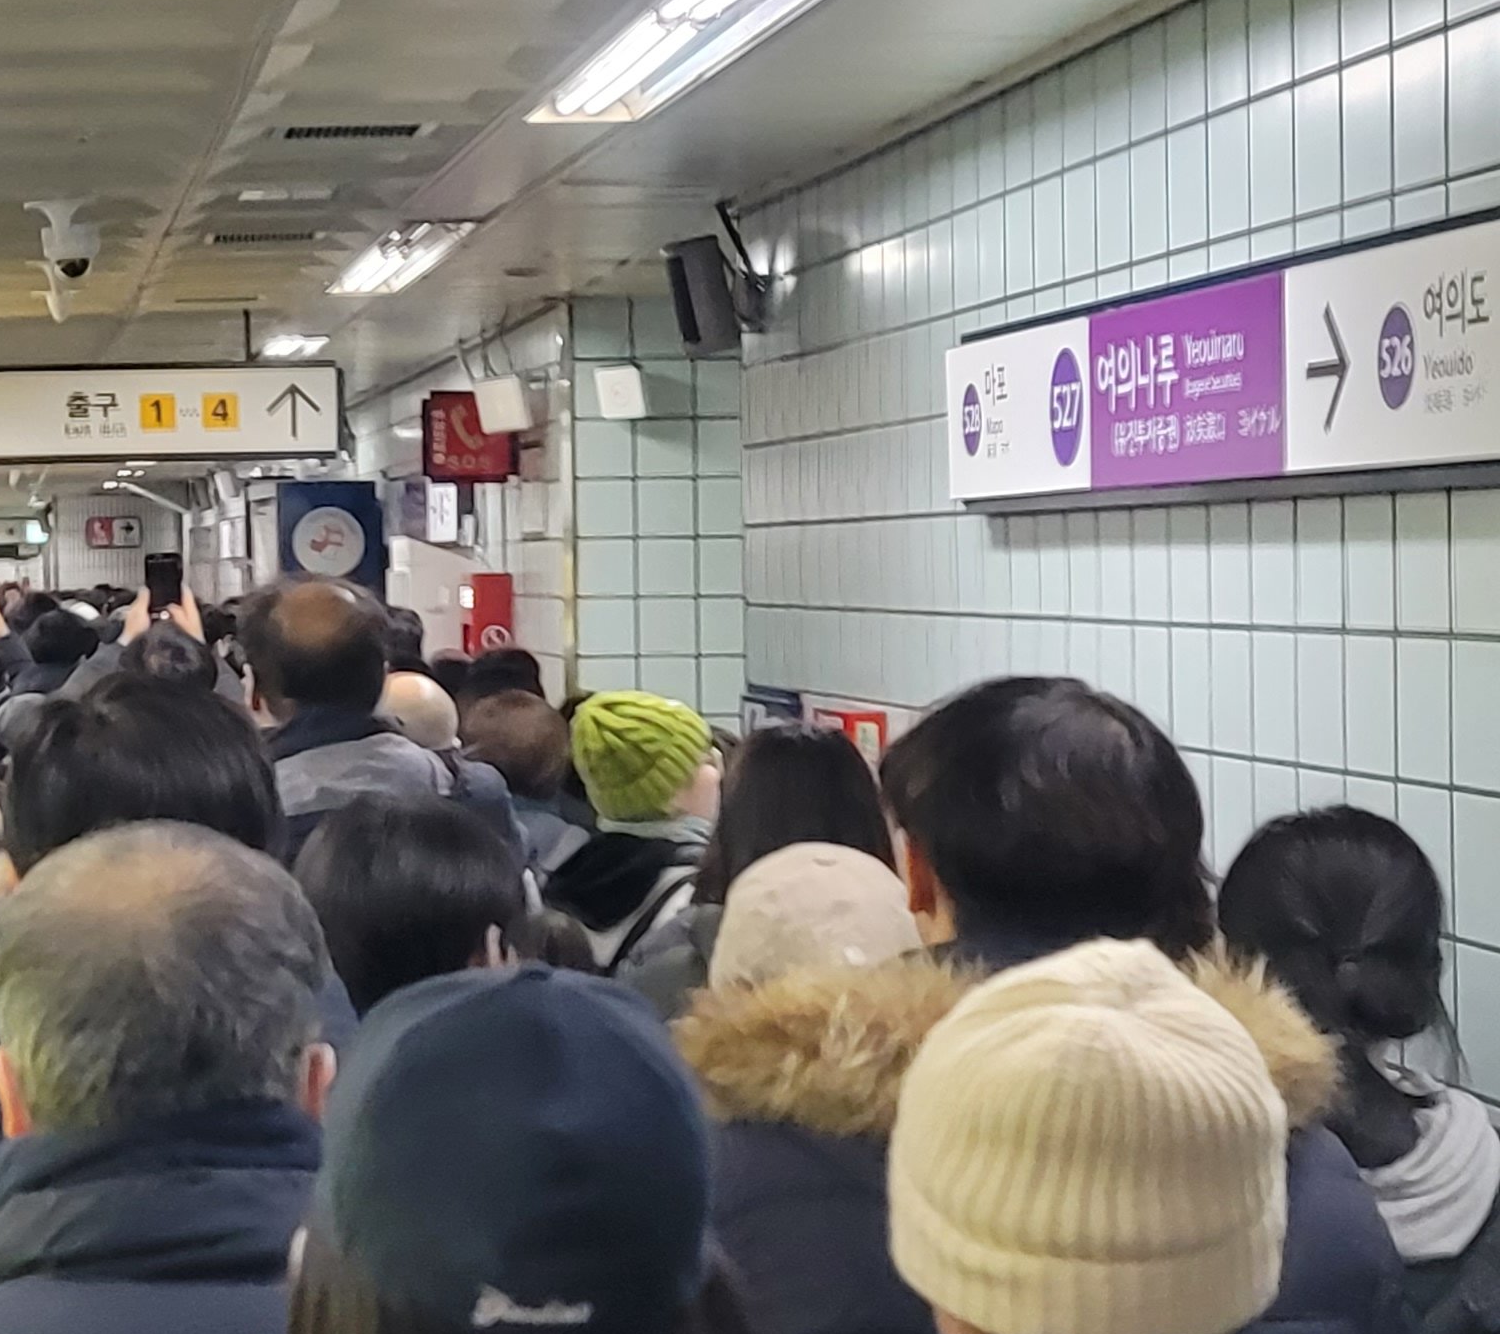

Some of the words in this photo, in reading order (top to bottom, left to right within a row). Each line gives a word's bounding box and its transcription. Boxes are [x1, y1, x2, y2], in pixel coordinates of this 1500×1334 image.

[1424, 269, 1490, 338] 여의도
[1097, 334, 1180, 414] 여의나루
[1380, 335, 1412, 379] 526
[985, 364, 1008, 406] 마포
[1053, 381, 1080, 429] 527
[66, 391, 120, 419] 출구
[150, 399, 162, 424] 1
[211, 398, 230, 424] 4
[964, 404, 980, 434] 528
